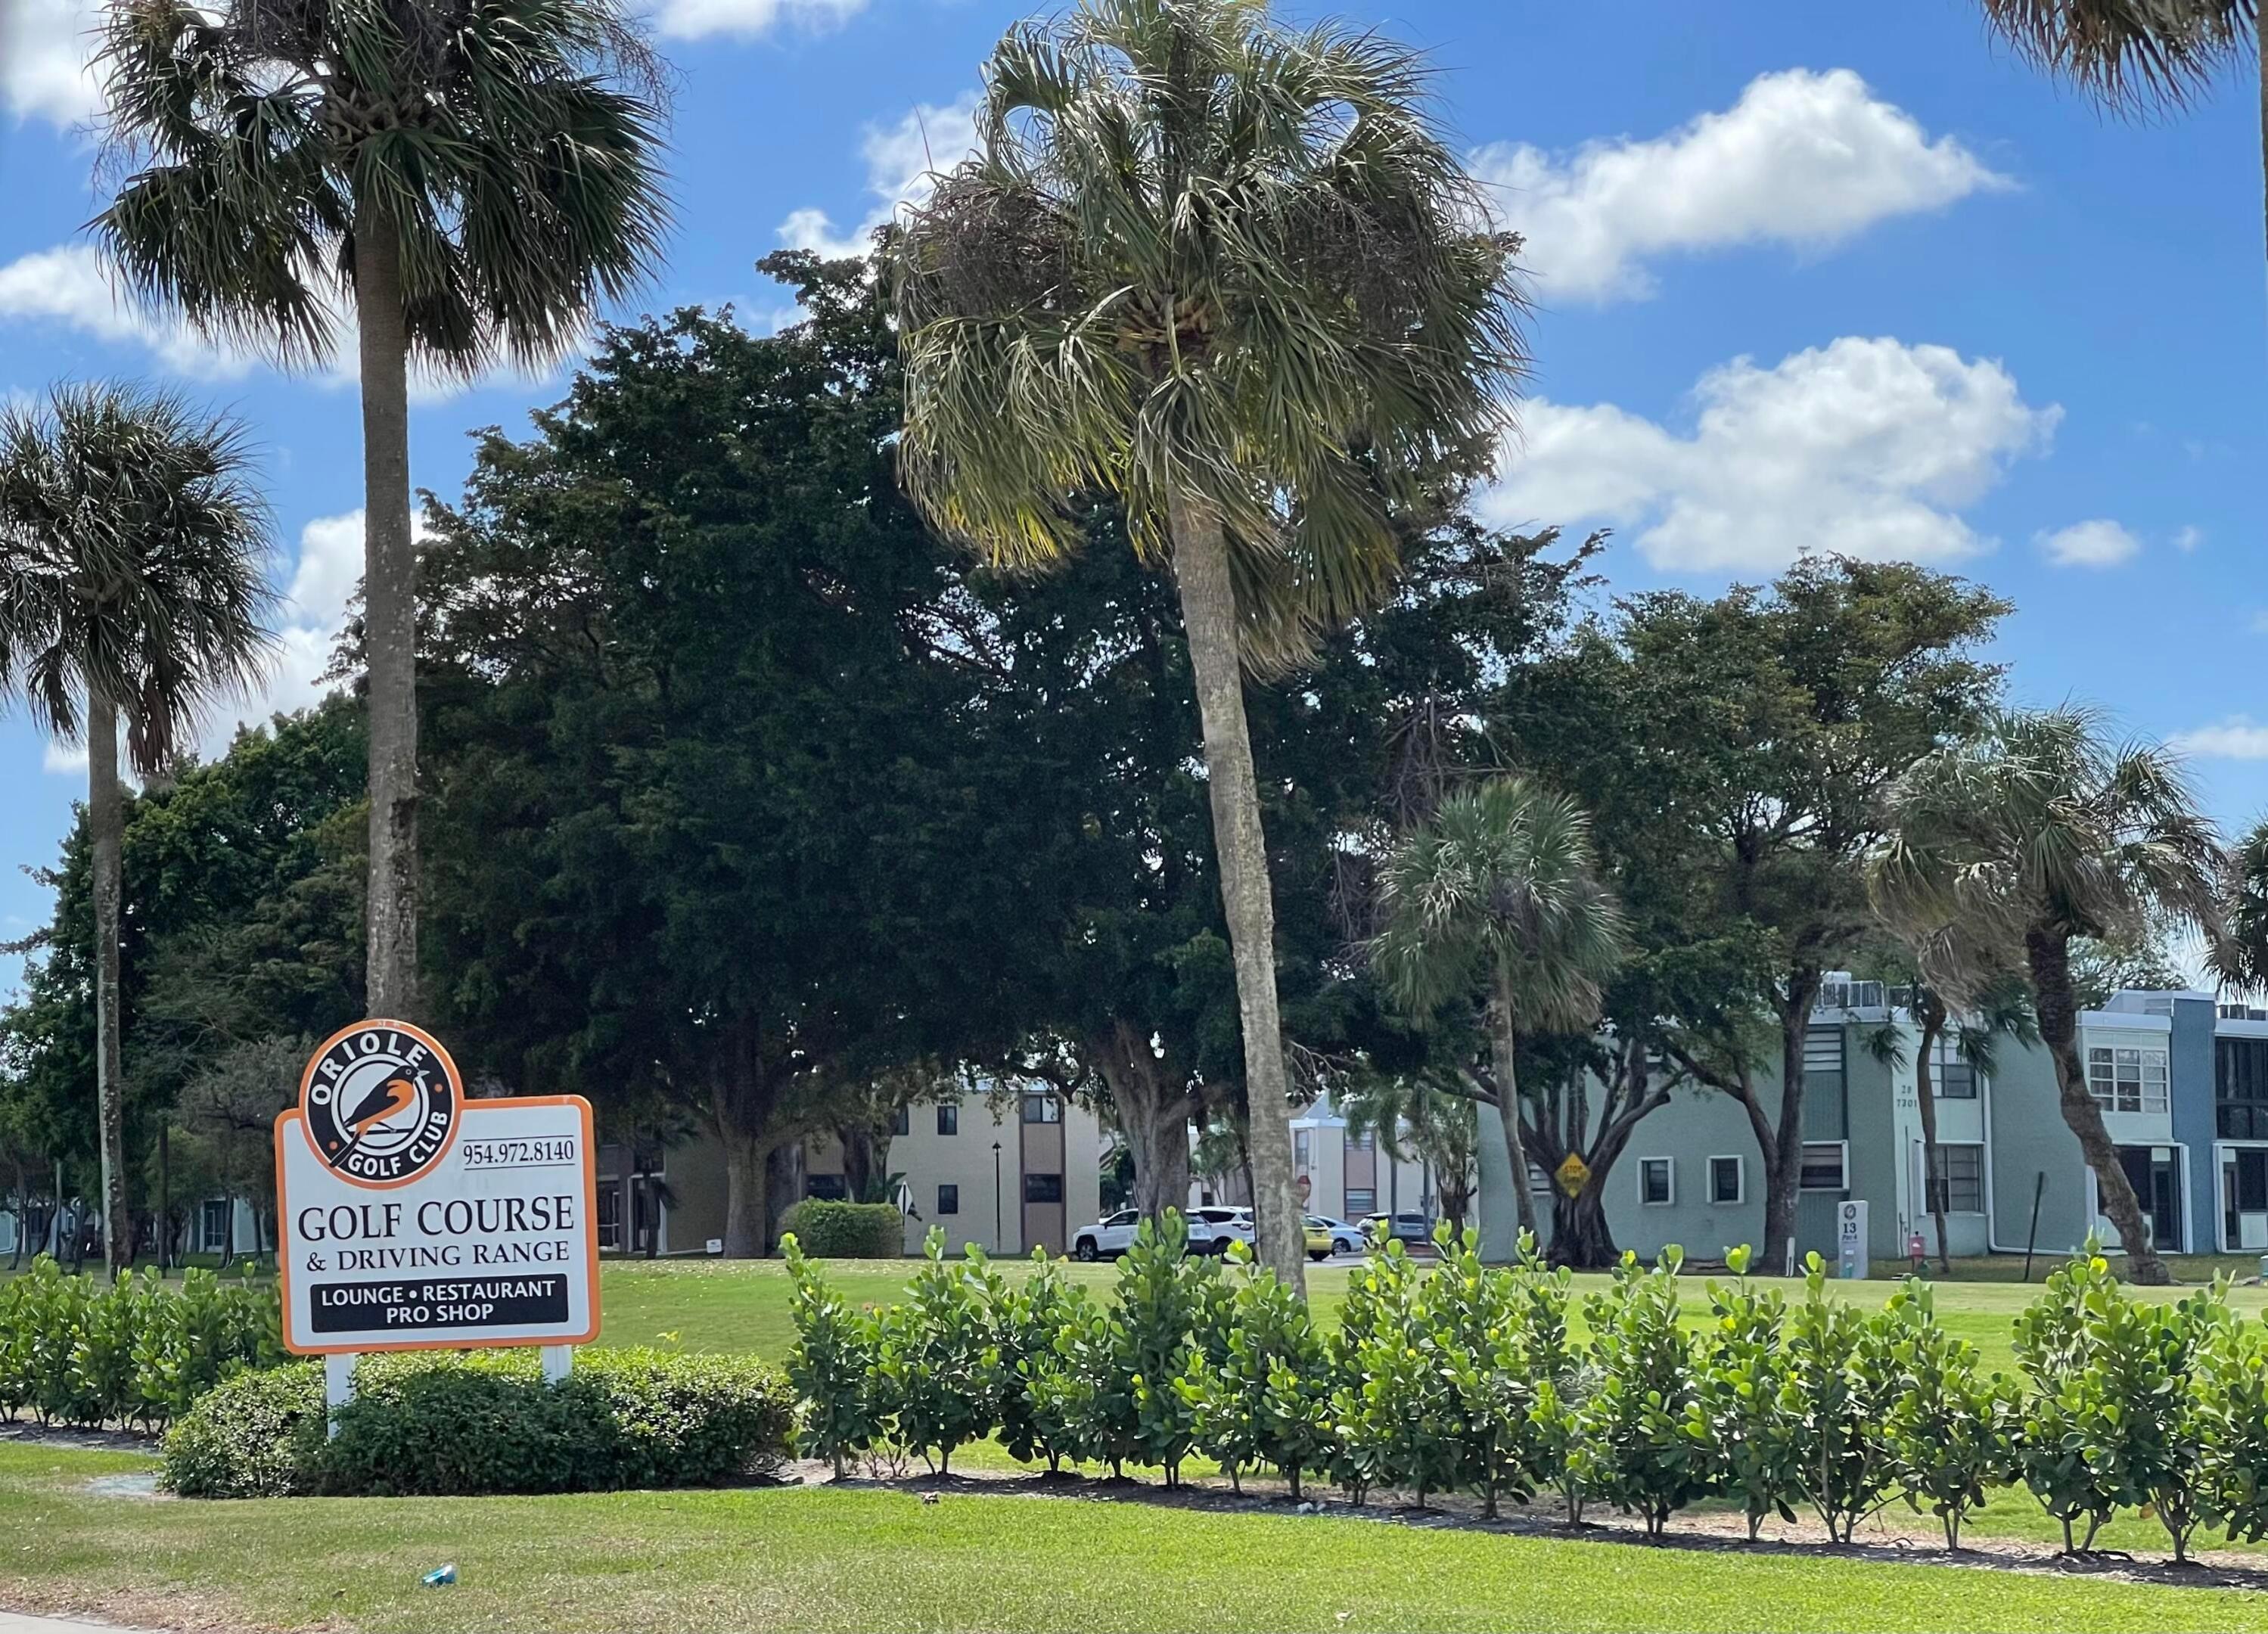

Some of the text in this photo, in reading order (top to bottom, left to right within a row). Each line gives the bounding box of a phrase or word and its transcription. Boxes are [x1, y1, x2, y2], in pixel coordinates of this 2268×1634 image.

[311, 1033, 428, 1105] ORIOLE
[1897, 1098, 1918, 1108] 7301
[347, 1111, 448, 1176] GOLF CLUB
[463, 1140, 574, 1165] 954.972.8140
[298, 1195, 575, 1241] GOLF COURSE
[1844, 1222, 1856, 1234] 13
[306, 1241, 570, 1272] & DRIVING RANGE
[321, 1280, 557, 1306] LOUNGE RESTAURANT
[387, 1303, 495, 1324] PRO SHOP
